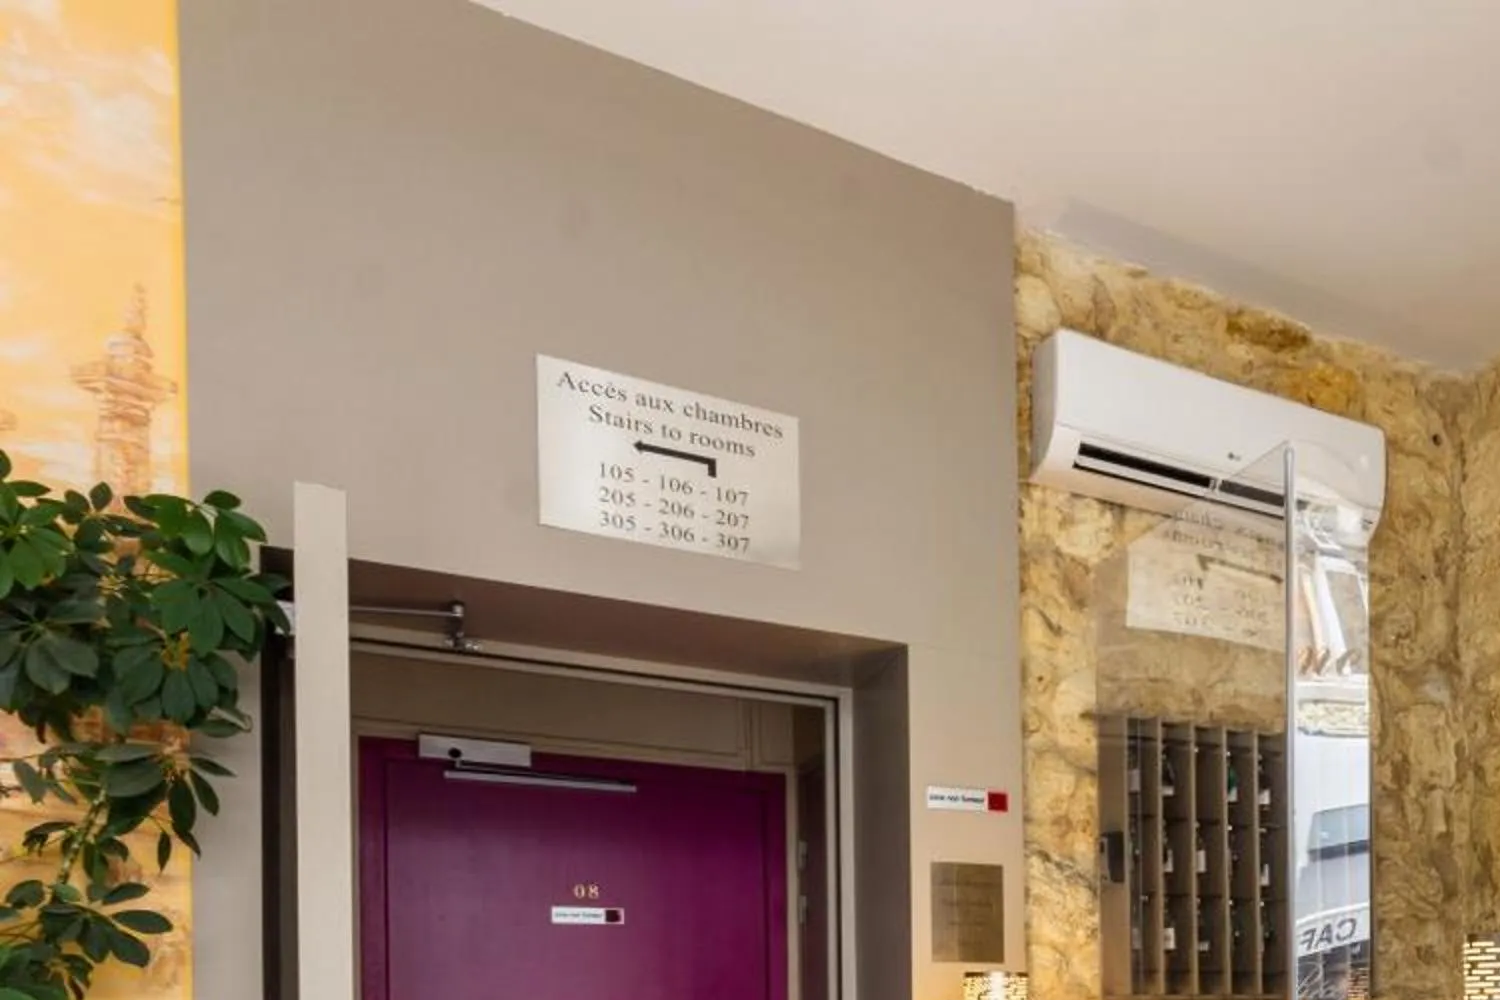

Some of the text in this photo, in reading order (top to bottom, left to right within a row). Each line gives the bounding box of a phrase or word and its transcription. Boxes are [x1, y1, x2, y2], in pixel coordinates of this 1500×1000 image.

[589, 403, 756, 457] Stairs to rooms
[635, 393, 674, 413] aux
[683, 401, 784, 438] chambres
[600, 462, 635, 483] 105
[660, 475, 694, 495] 106
[716, 487, 749, 506] 107
[599, 486, 636, 507] 205
[658, 497, 695, 518] 206
[716, 509, 749, 529] 207
[600, 510, 637, 531] 305
[659, 521, 695, 542] 306
[716, 532, 750, 555] 307
[573, 883, 600, 900] 08
